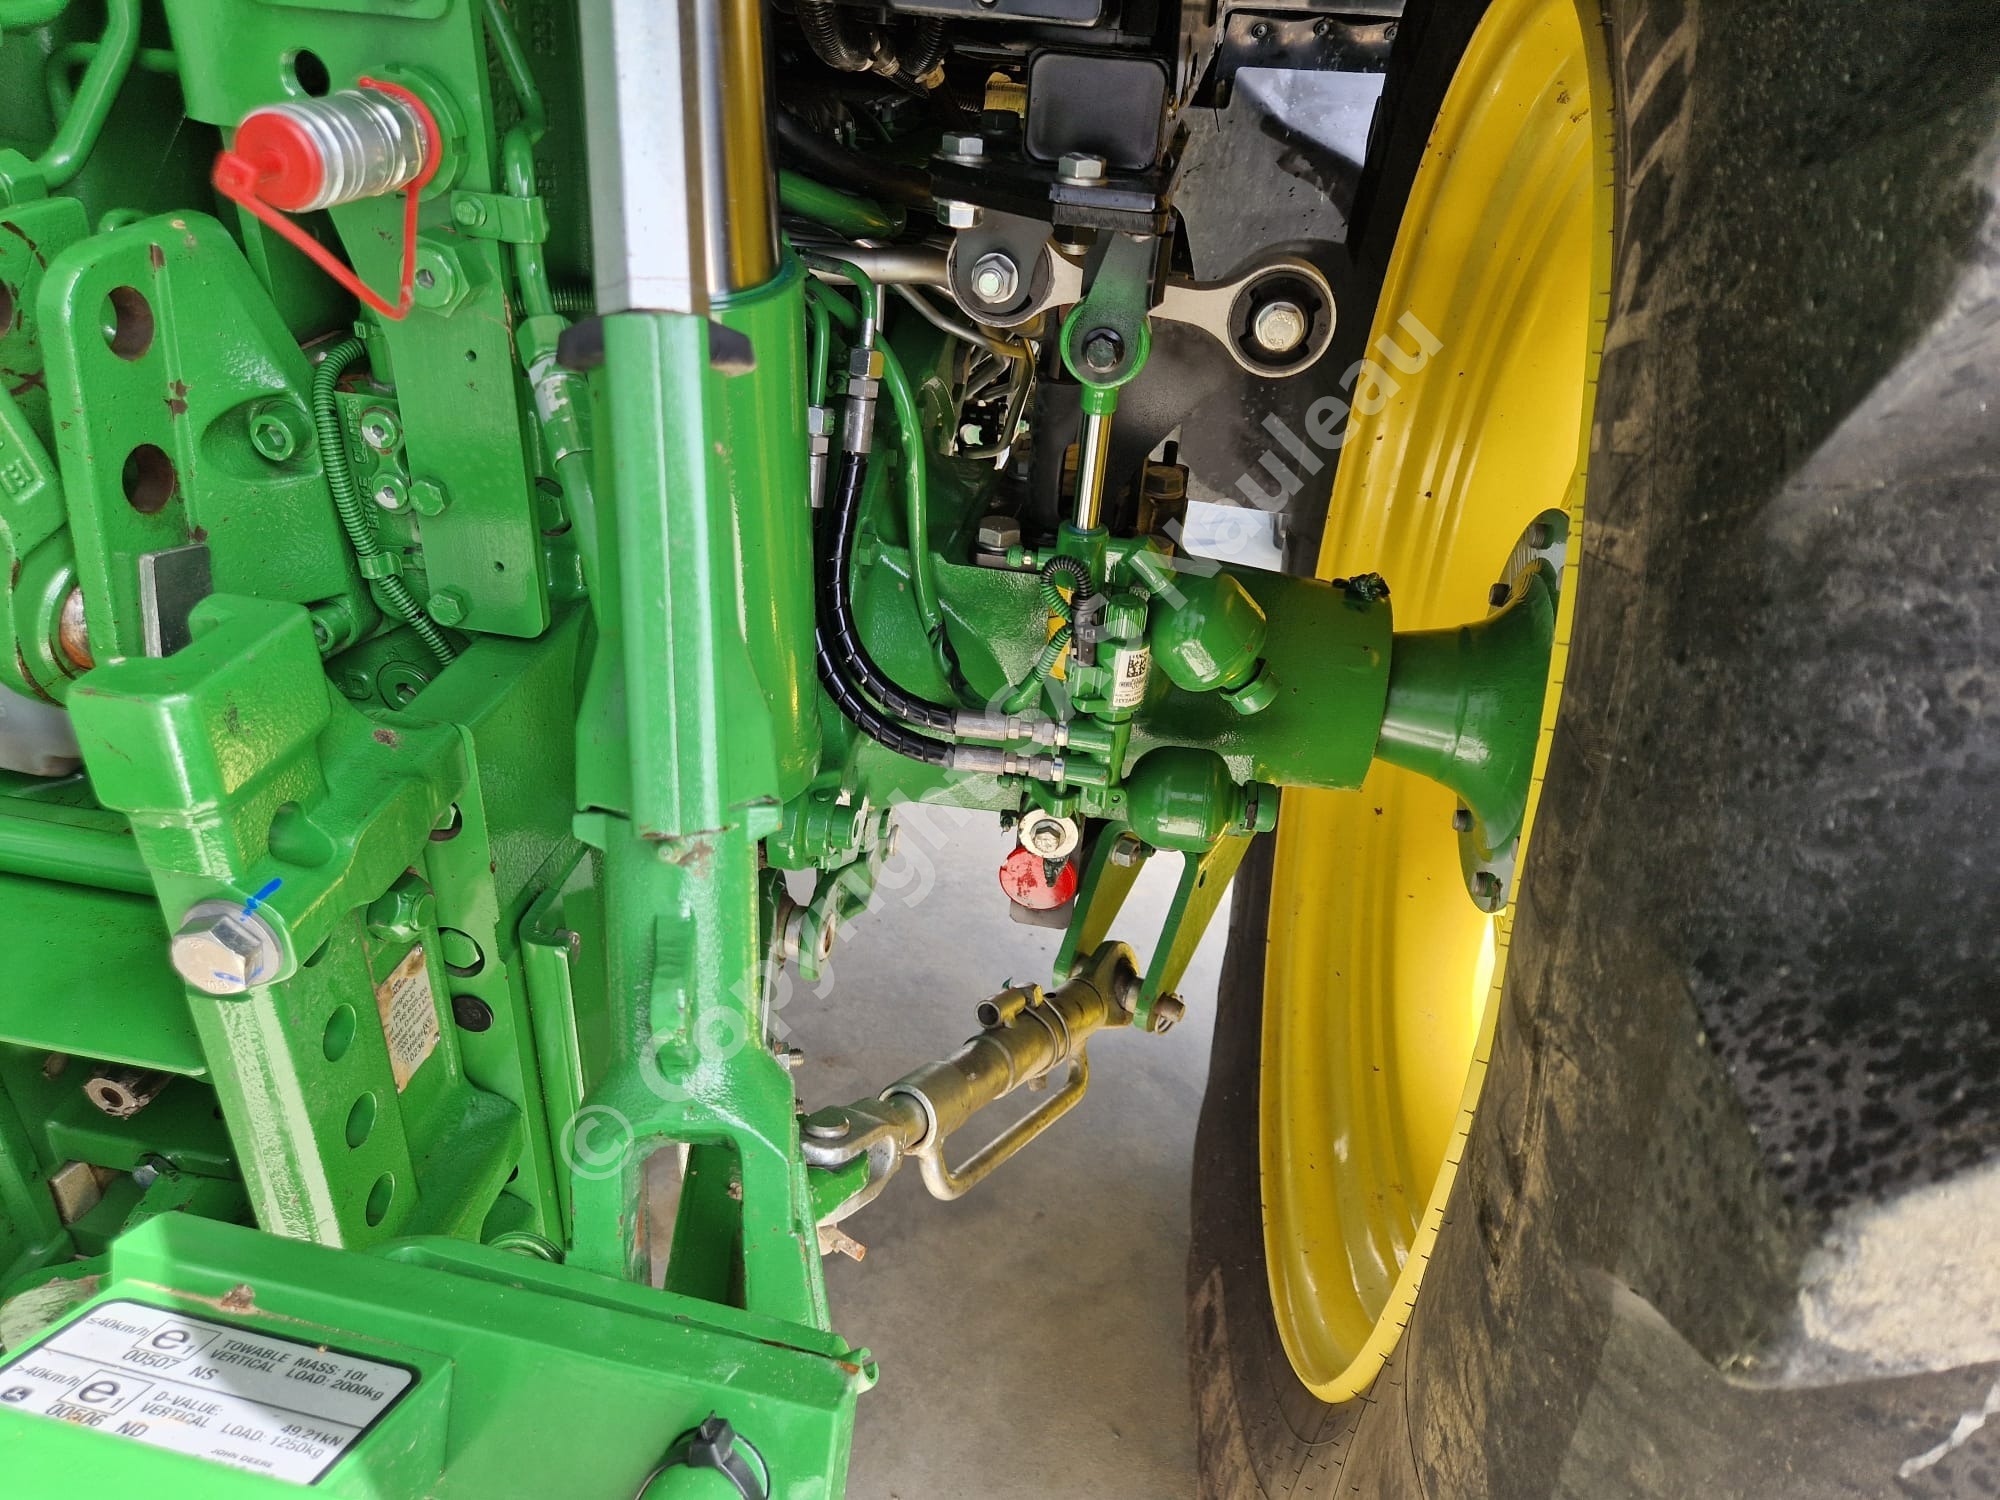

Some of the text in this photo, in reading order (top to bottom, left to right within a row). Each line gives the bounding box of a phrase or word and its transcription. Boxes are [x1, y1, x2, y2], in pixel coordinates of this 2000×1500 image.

[86, 1317, 150, 1336] ≤40km/h
[13, 1365, 82, 1387] >40km/h
[122, 1349, 220, 1381] 00507 NS
[209, 1349, 384, 1401] VERTICAL LOAD: 2000kg
[222, 1339, 368, 1382] TOWABLE MASS: 10t
[45, 1403, 150, 1438] 00506 ND
[140, 1401, 325, 1459] VERTICAL LOAD: 1250kg
[153, 1391, 344, 1447] D-VALUE: 49,21kN
